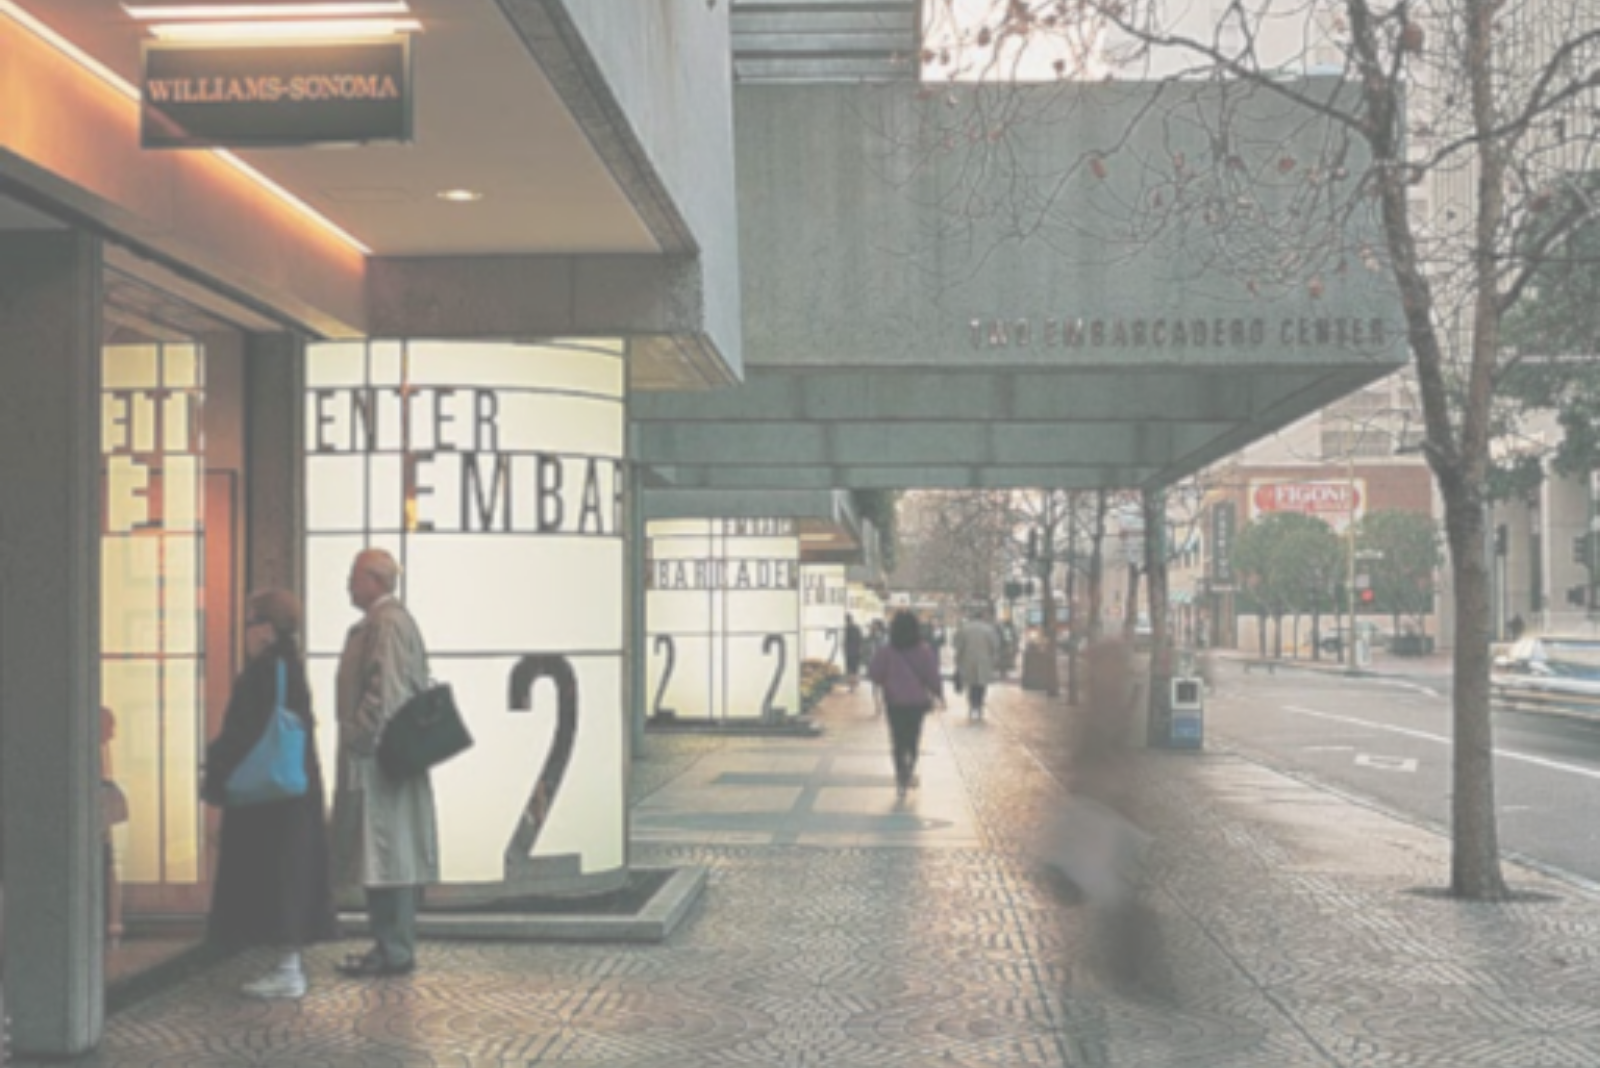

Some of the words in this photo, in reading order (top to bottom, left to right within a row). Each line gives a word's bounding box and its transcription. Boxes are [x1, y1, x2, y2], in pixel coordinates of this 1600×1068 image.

[147, 74, 398, 103] WILLIAMS-SONOMA
[1043, 316, 1264, 348] EMBARCADERO
[1280, 316, 1386, 348] CENTER
[314, 387, 500, 452] ENTER
[503, 654, 581, 880] 2
